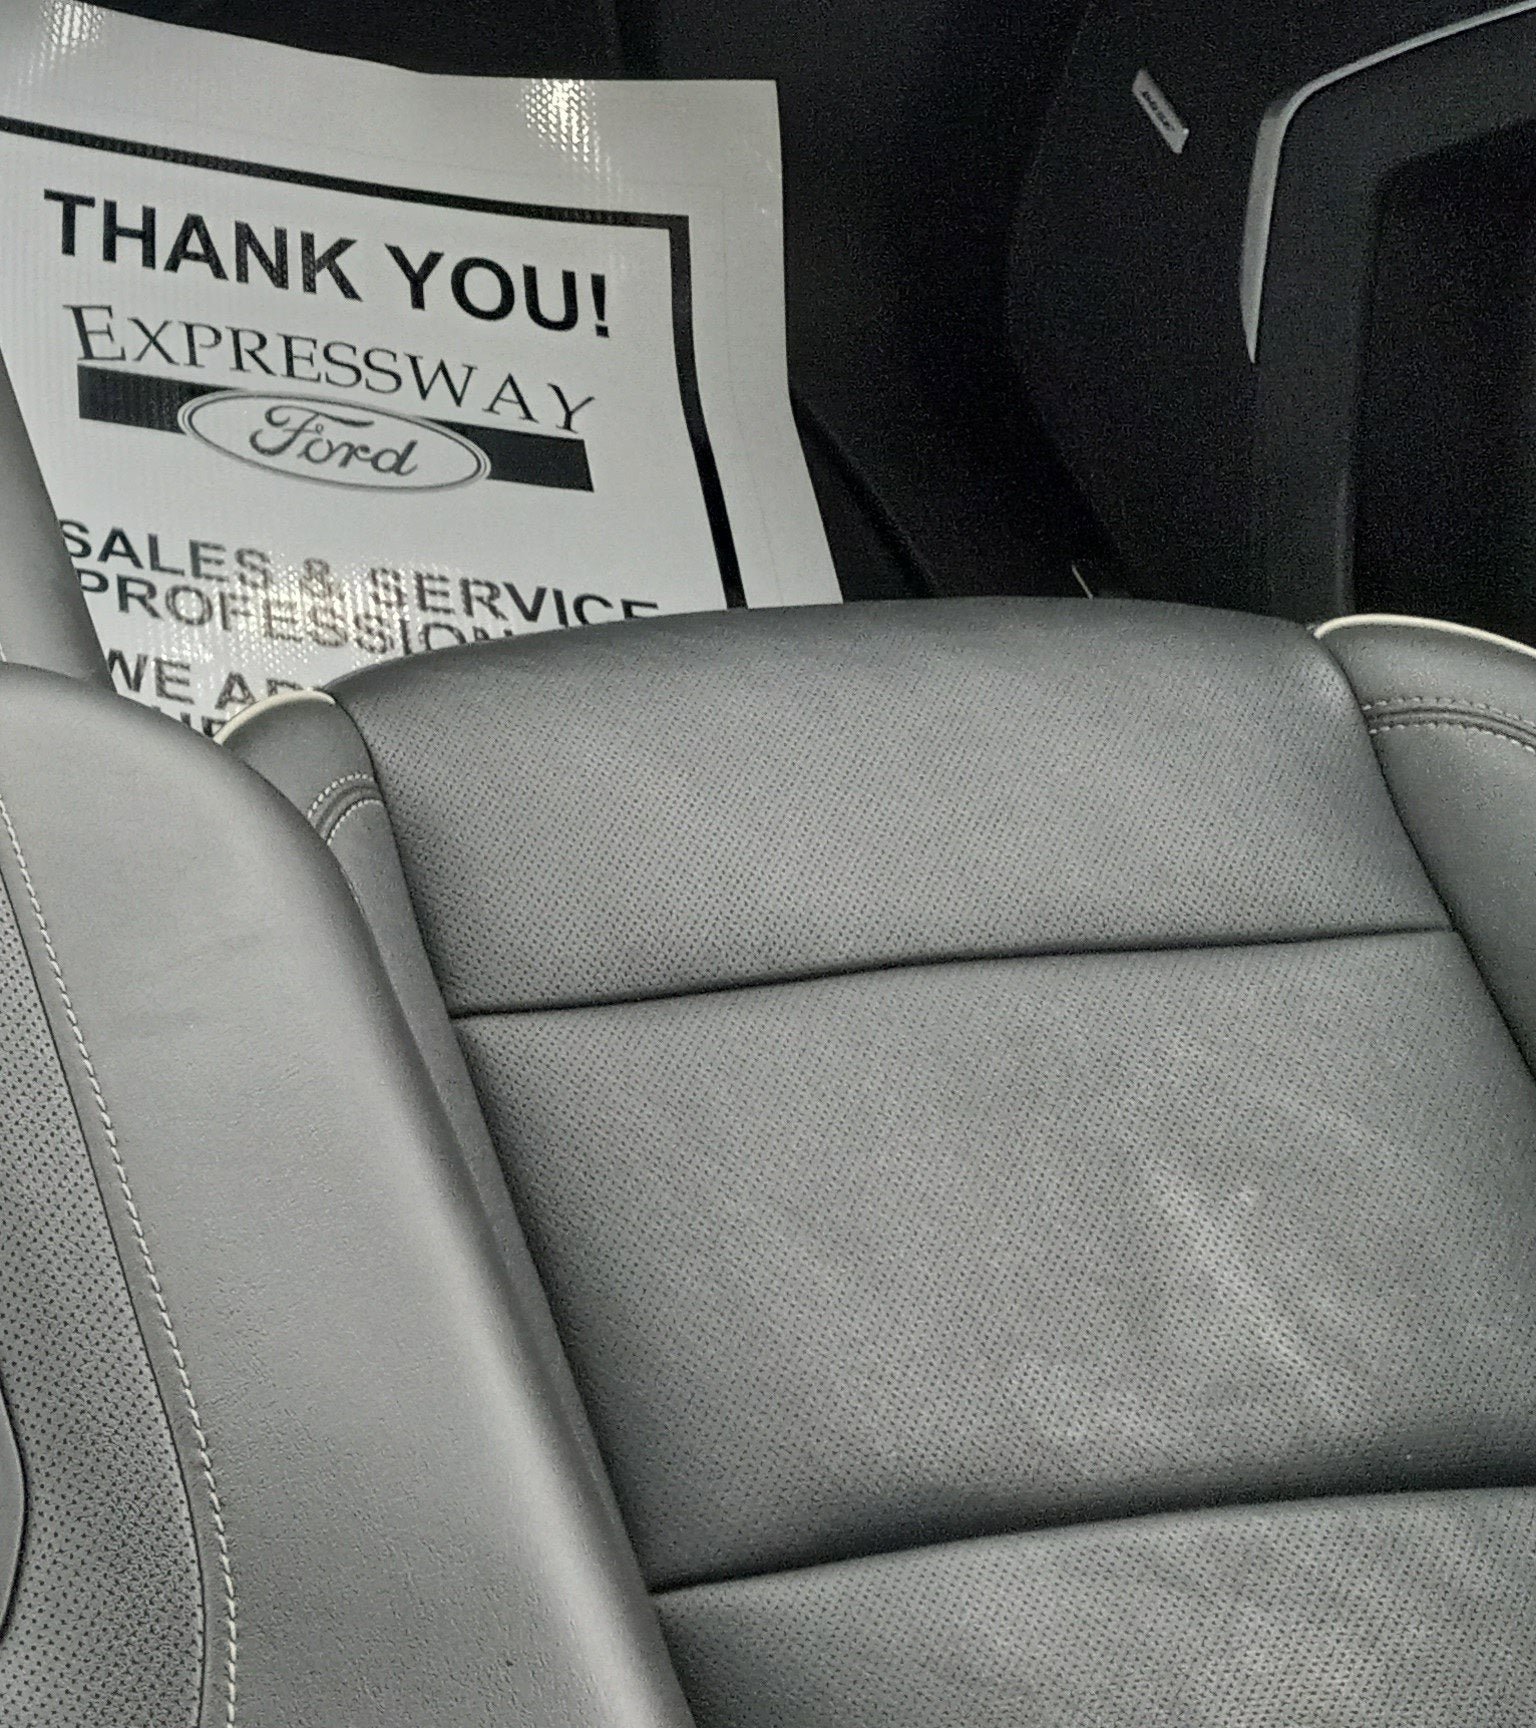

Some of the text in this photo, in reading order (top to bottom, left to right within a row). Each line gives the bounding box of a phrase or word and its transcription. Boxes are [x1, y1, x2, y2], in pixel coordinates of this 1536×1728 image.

[43, 188, 611, 339] THANK YOU!
[63, 304, 595, 435] EXPRESSWAY
[248, 405, 418, 477] Ford
[59, 518, 271, 590] SALES
